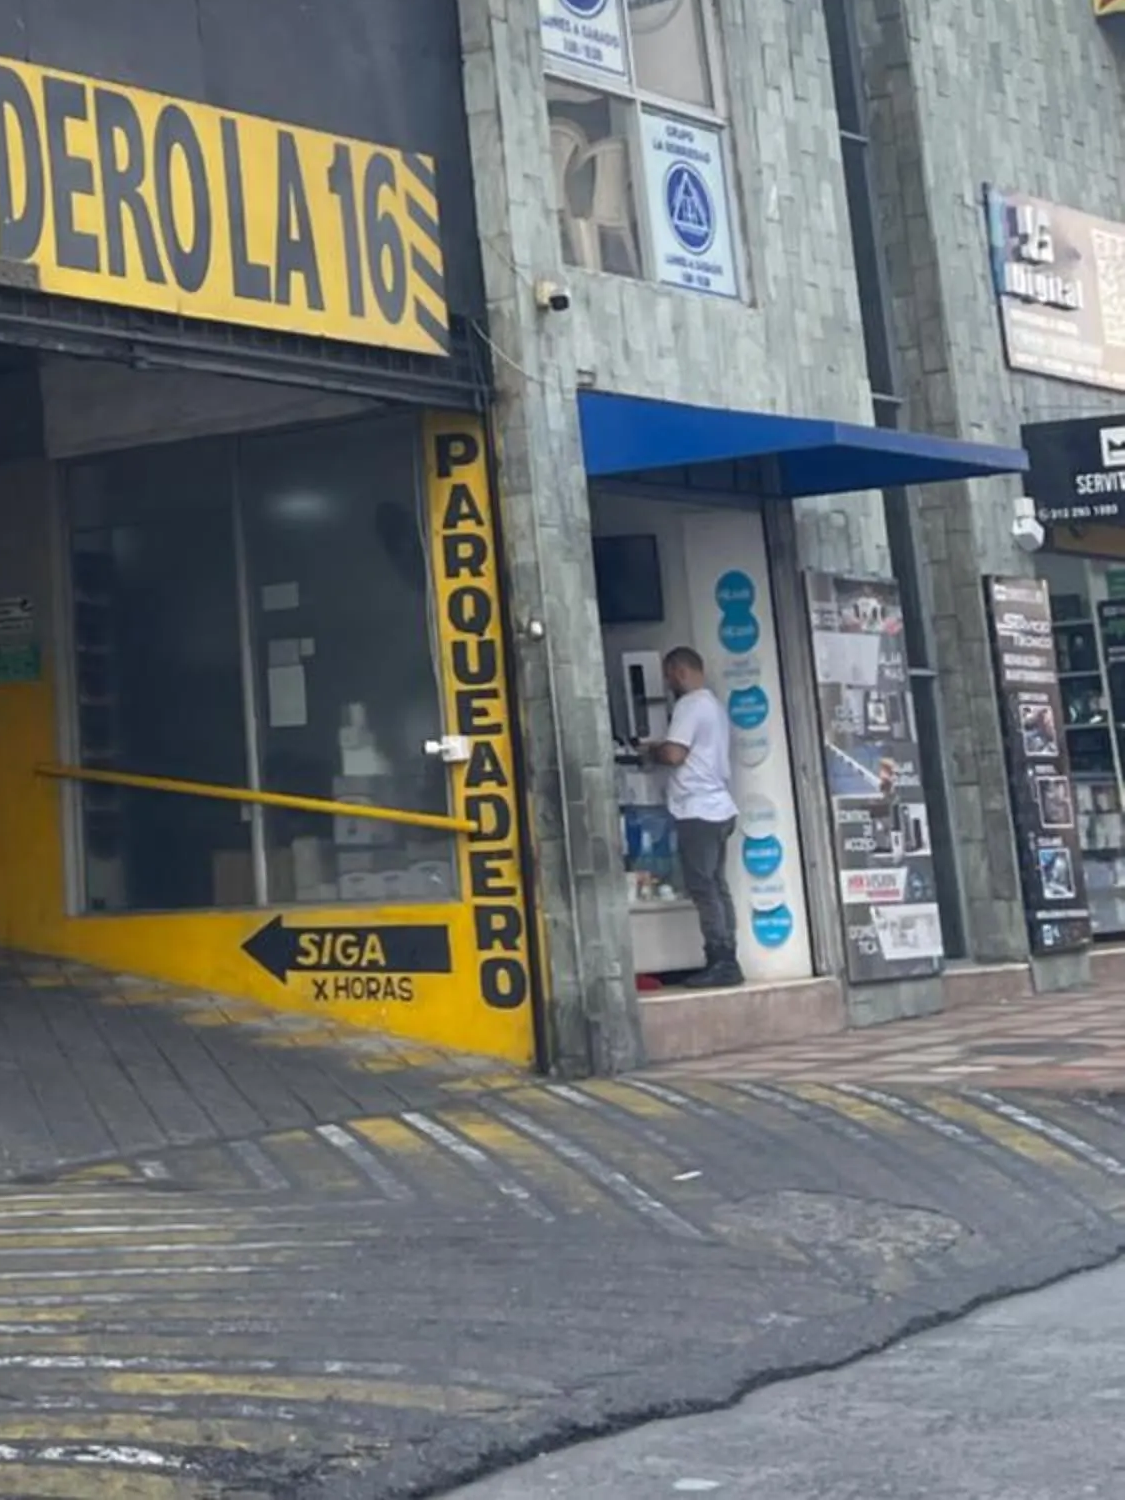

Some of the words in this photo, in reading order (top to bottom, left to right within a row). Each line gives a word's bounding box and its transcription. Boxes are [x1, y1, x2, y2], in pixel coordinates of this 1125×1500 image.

[220, 117, 325, 311] LA
[328, 144, 407, 324] 16
[434, 432, 528, 1009] PARQUEADERO
[296, 933, 386, 967] SIGA
[334, 977, 413, 1001] HORAS
